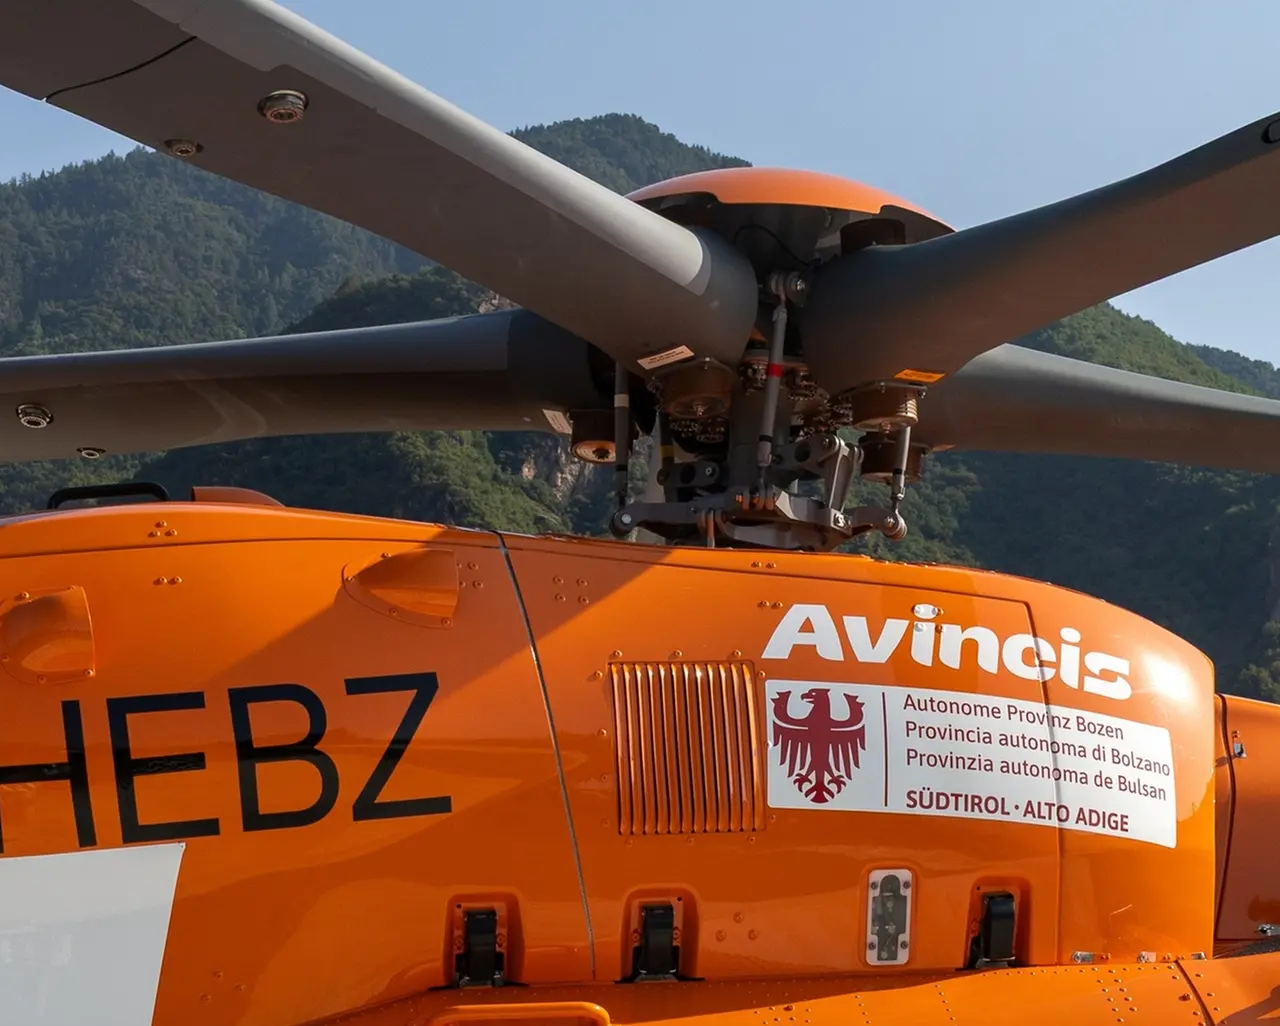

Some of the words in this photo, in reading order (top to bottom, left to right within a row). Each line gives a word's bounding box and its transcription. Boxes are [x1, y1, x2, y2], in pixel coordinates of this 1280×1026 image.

[761, 603, 1133, 700] Avincis
[903, 693, 1002, 720] Autonome
[1007, 704, 1071, 730] Provinz
[1075, 711, 1124, 741] Bozen
[905, 721, 993, 746] Provincia
[998, 733, 1088, 760] autonoma
[1091, 741, 1108, 762] di
[1111, 743, 1171, 778] Bolzano
[906, 749, 994, 774] Provinzia
[1000, 759, 1089, 787] autonoma
[1093, 768, 1113, 791] de
[1117, 775, 1167, 802] Bulsan
[905, 786, 1010, 817] SÜDTIROL
[1023, 798, 1070, 824] ALTO
[1075, 808, 1130, 834] ADIGE
